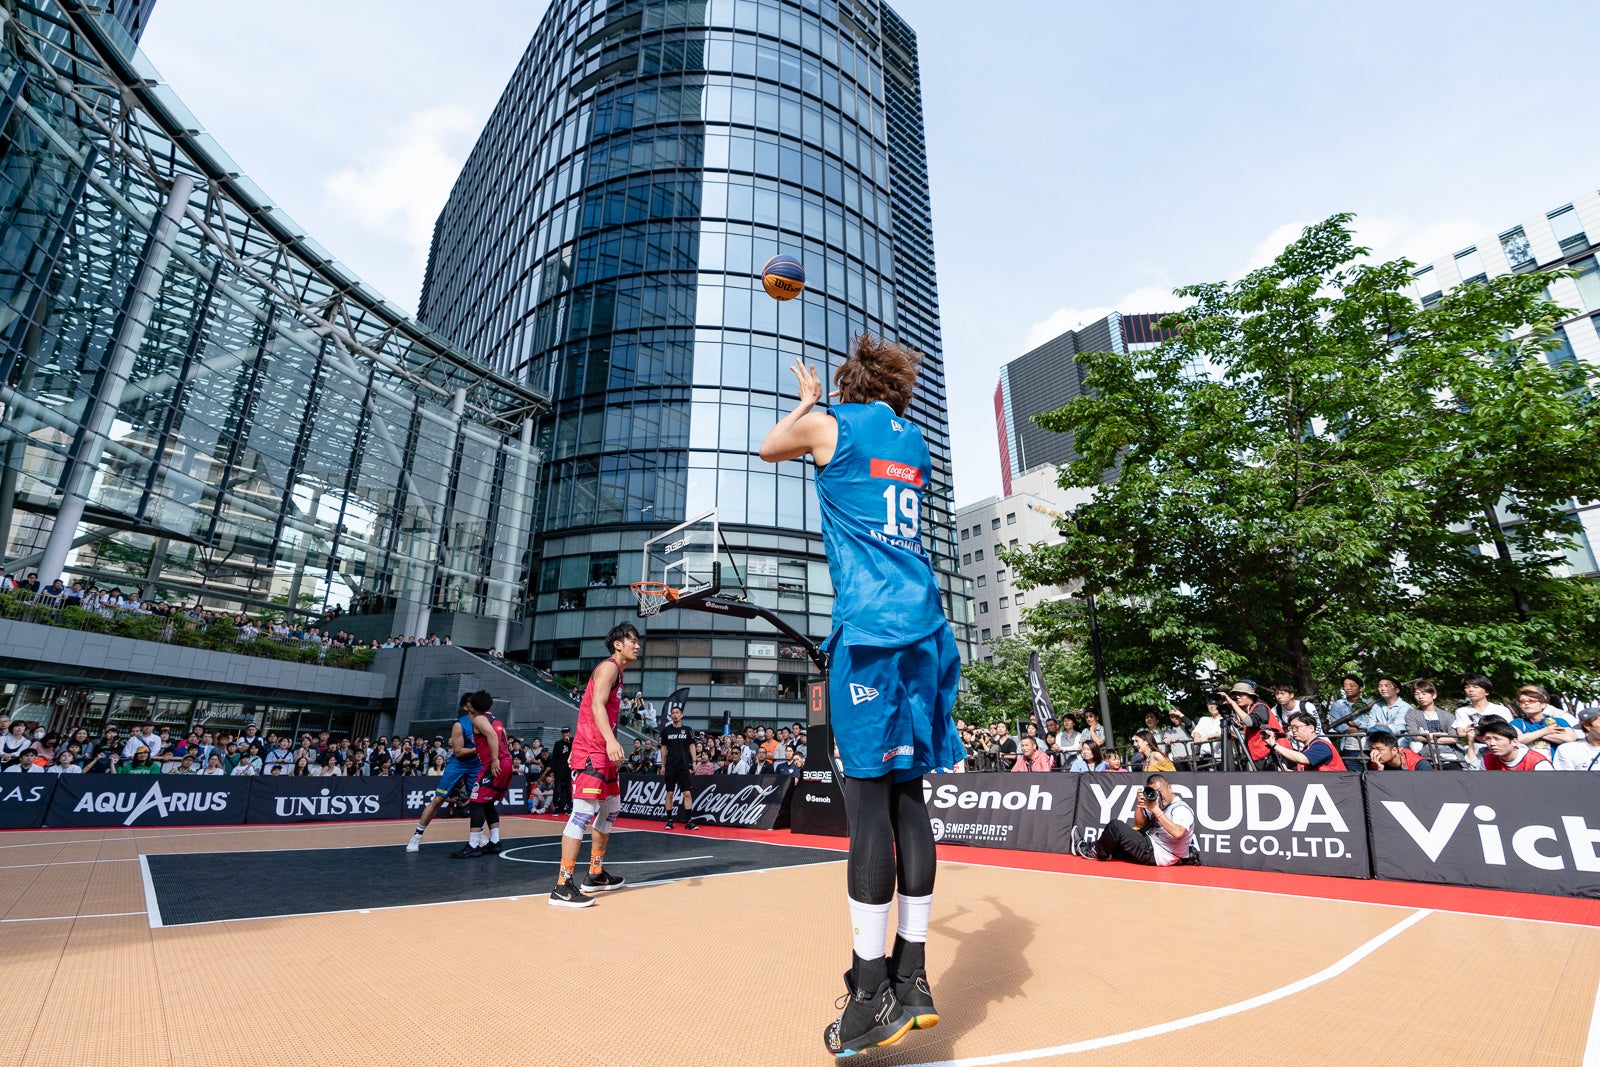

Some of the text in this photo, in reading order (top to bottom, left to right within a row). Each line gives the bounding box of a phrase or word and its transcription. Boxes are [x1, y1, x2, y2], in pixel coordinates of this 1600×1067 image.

[883, 484, 919, 539] 19
[74, 780, 230, 826] AQUARIUS
[934, 784, 1053, 811] Senoh
[1239, 835, 1352, 860] CO.,LTD.
